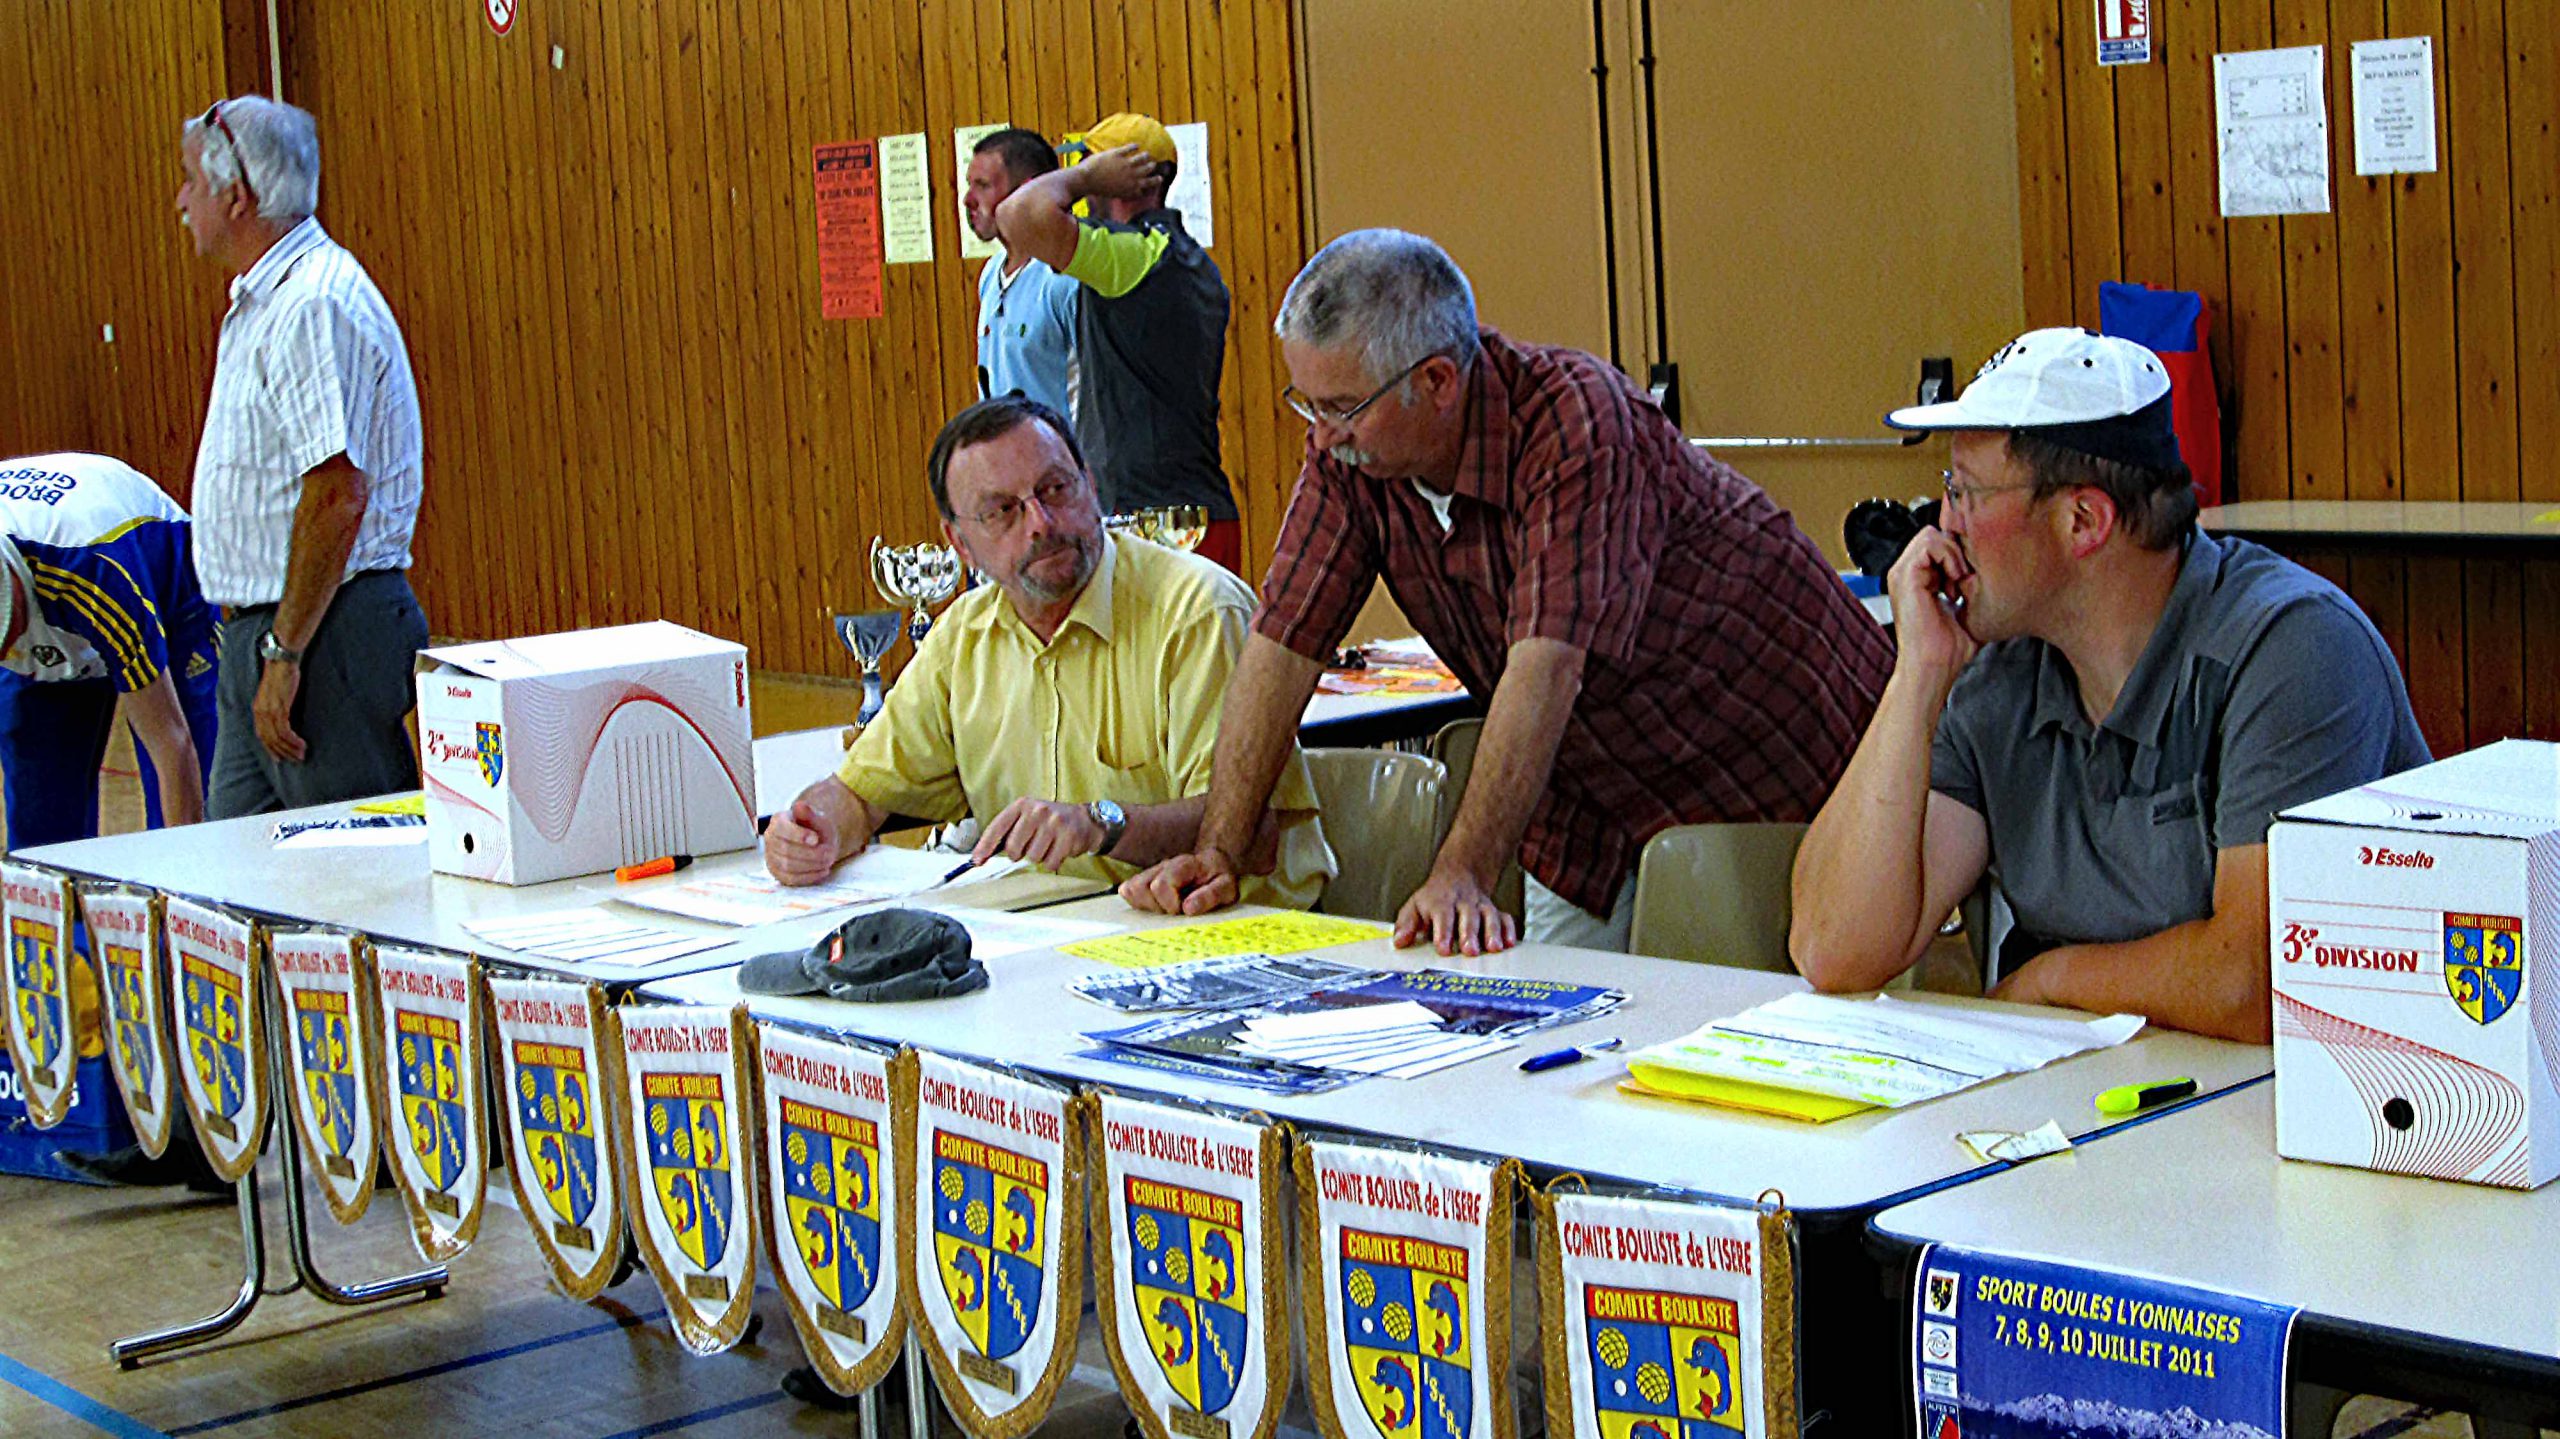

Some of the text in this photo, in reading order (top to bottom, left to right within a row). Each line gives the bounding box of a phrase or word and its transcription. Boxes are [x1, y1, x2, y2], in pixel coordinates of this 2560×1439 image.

[2315, 946, 2417, 972] DIVISION
[625, 1025, 728, 1053] COMITE BOULISTE de L'ISERE
[764, 1047, 886, 1105] COMITE BOULISTE de L'ISERE
[785, 1103, 875, 1145] COMITE BOULISTE
[923, 1076, 1060, 1145] COMITE BOULISTE de L'ISERE
[939, 1135, 1043, 1186] COMITE BOULISTE
[1107, 1120, 1254, 1180] COMITE BOULISTE de L'ISERE
[1132, 1180, 1238, 1227] COMITE BOULISTE
[1321, 1168, 1481, 1226] COMITE BOULISTE de L'ISERE
[1348, 1233, 1465, 1276] COMITE BOULISTE
[1564, 1222, 1752, 1276] COMITE BOULISTE de L'ISERE
[993, 1255, 1028, 1336] ISERE
[1594, 1290, 1733, 1332] COMITE BOULISTE
[1976, 1275, 2241, 1344] SPORT BOULES LYONNAISES
[1199, 1304, 1235, 1389] ISERE
[1994, 1315, 2216, 1378] 7, 8, 9, 10 JUILLET 2011
